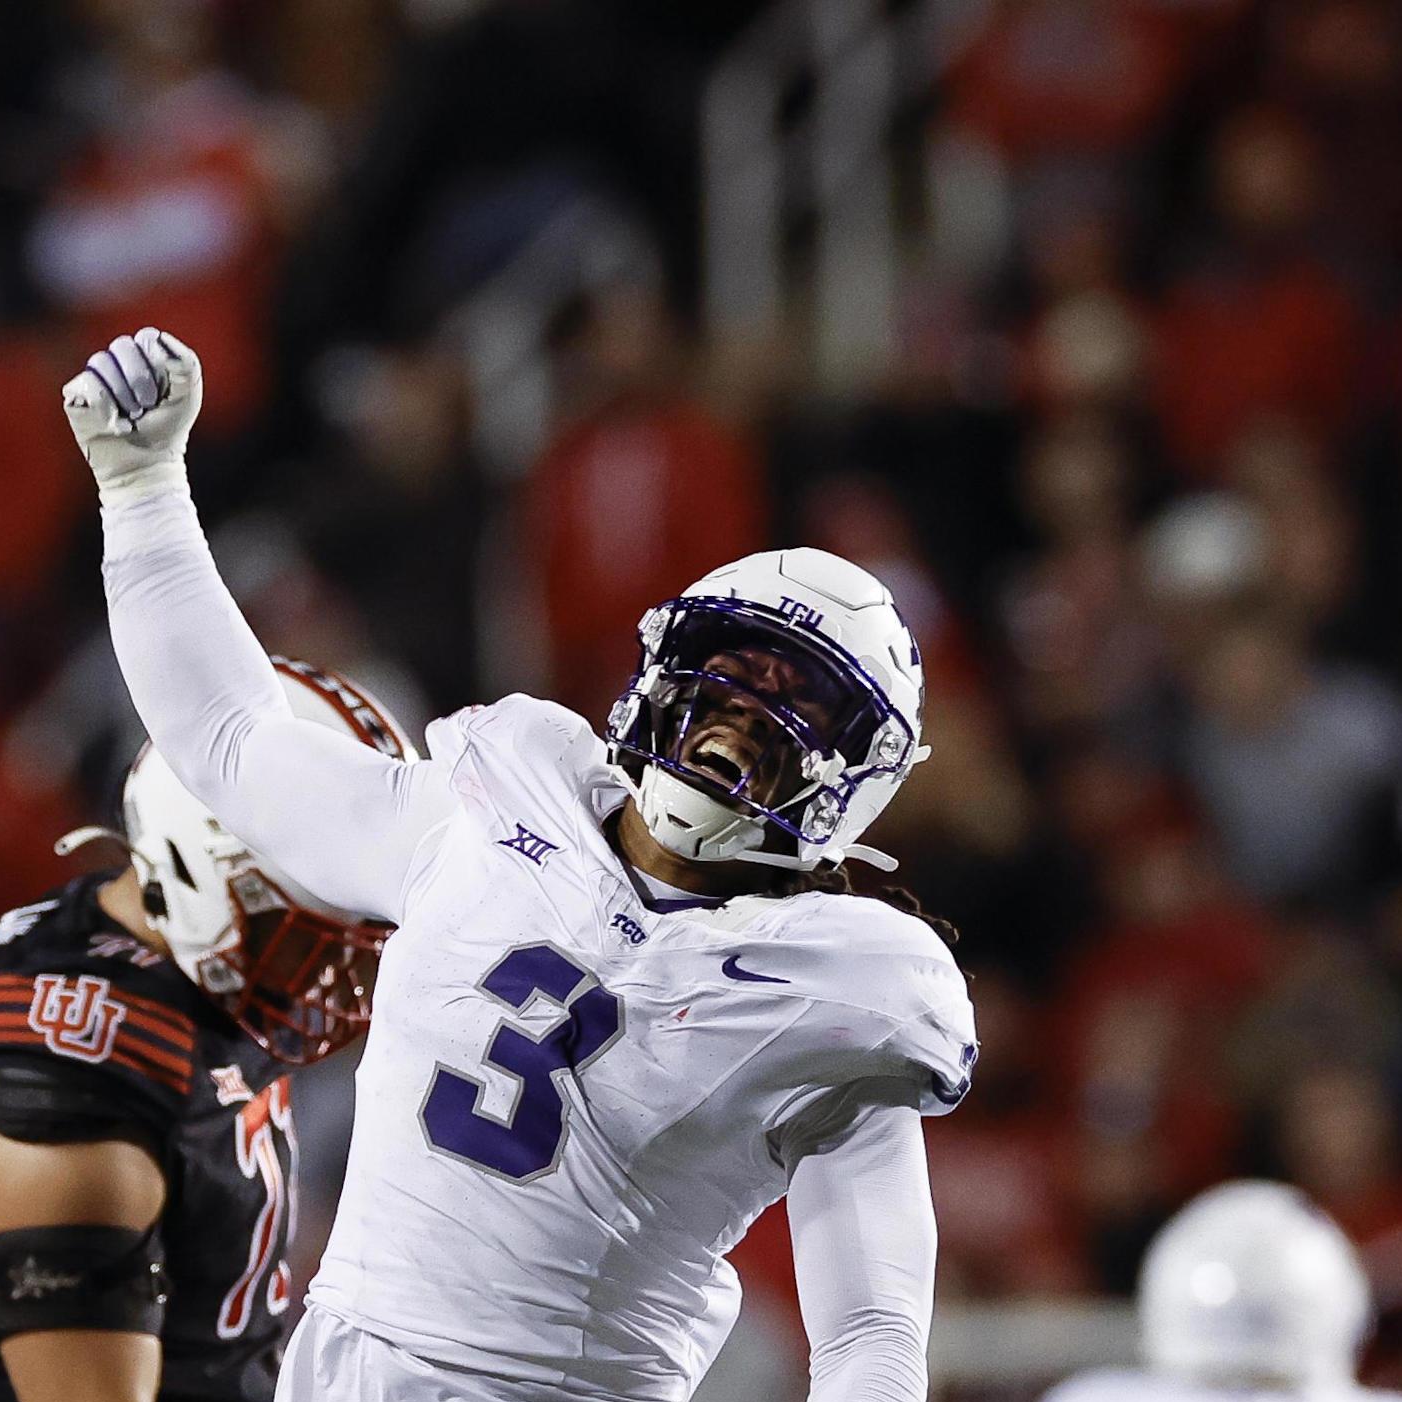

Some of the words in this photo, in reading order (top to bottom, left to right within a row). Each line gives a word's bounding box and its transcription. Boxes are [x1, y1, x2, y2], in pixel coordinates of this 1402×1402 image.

[778, 596, 824, 629] TCU
[610, 913, 646, 944] TCU
[417, 940, 626, 1187] 3
